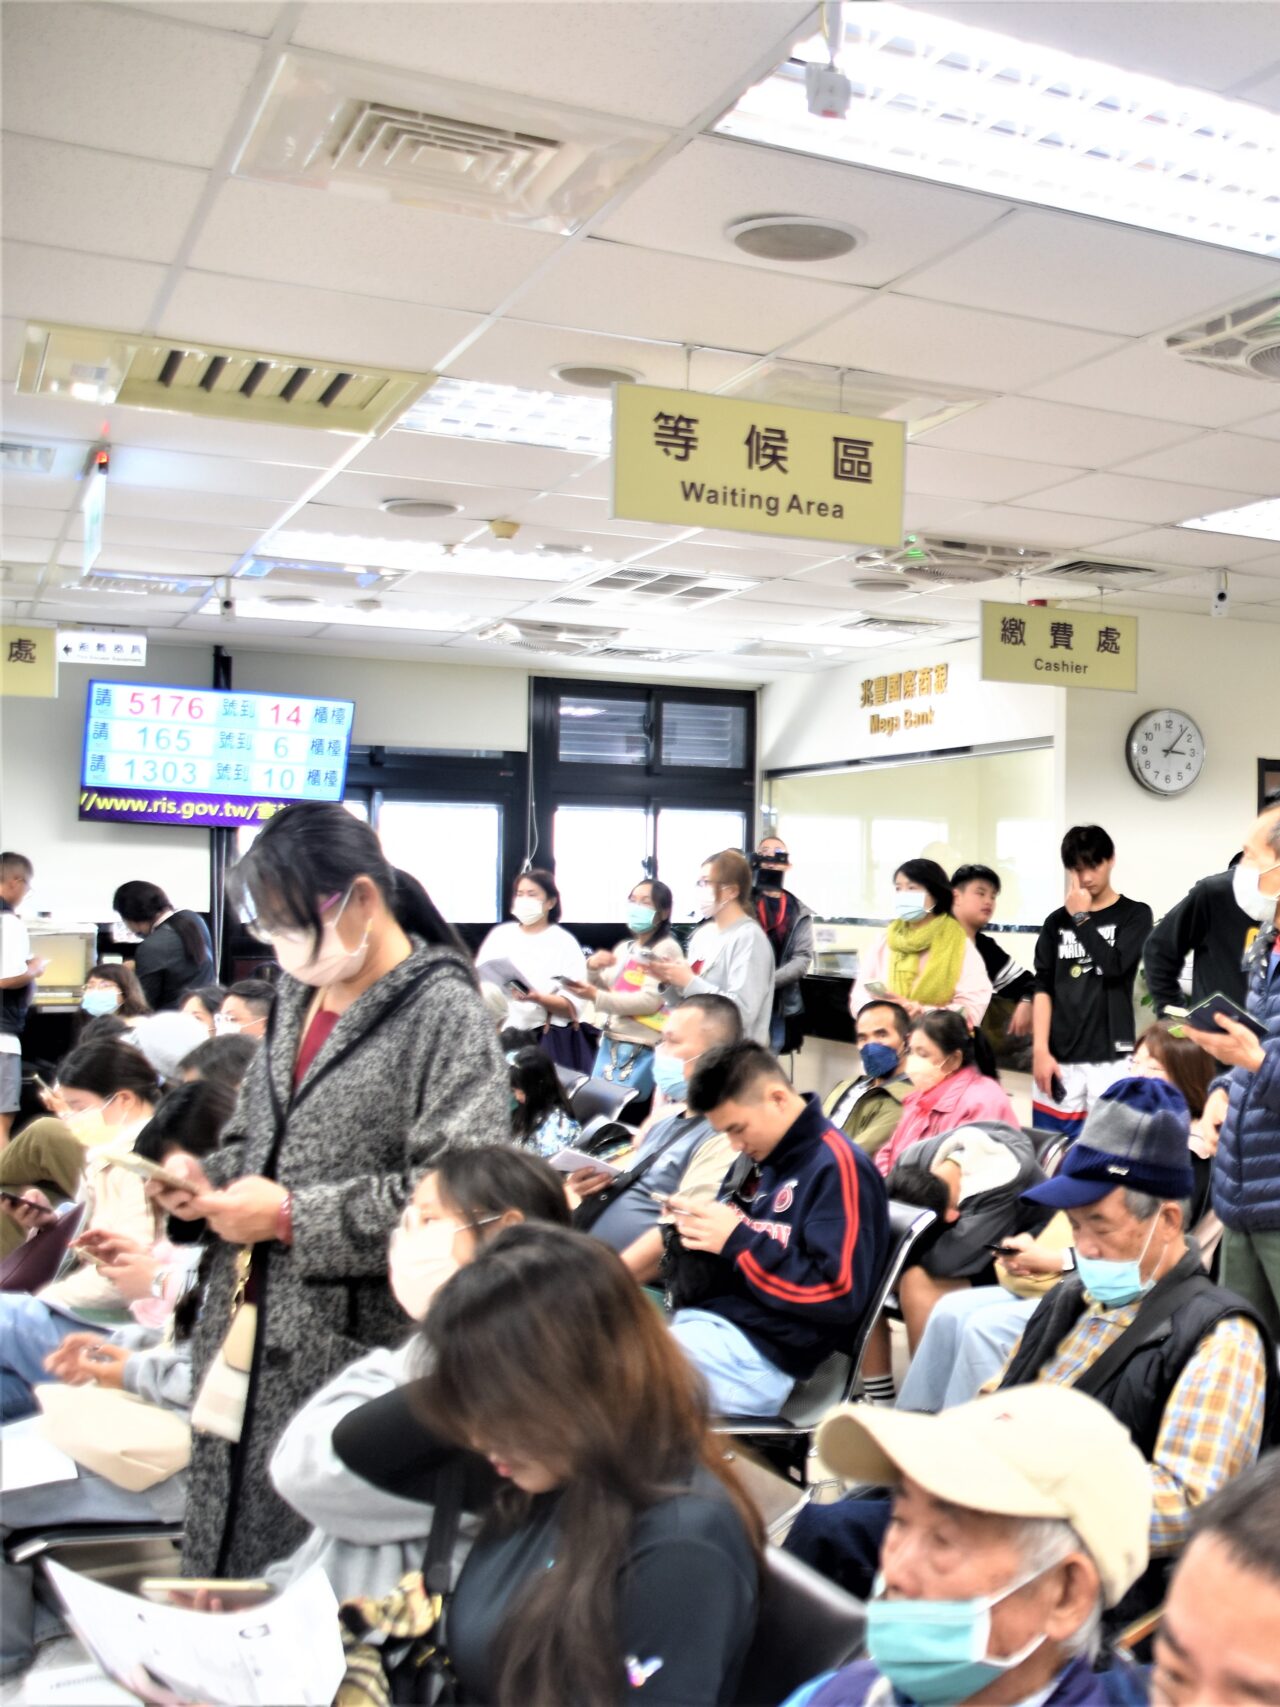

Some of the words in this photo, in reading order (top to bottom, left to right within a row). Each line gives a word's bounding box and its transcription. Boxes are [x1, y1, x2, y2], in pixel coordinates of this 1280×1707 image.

[653, 411, 874, 484] 等候區
[680, 481, 779, 516] Waiting
[786, 494, 844, 519] Area
[1000, 617, 1121, 654] 繳費處
[8, 638, 36, 663] 處
[1034, 658, 1088, 674] Cashier
[129, 692, 203, 719] 5176
[271, 704, 301, 725] 14
[870, 714, 900, 737] Mega
[904, 705, 935, 729] Bank
[1165, 720, 1173, 729] 12
[1154, 723, 1160, 731] 11
[1144, 732, 1153, 741] 10
[1186, 734, 1192, 743] 2
[138, 727, 191, 751] 165
[274, 737, 288, 758] 6
[1141, 746, 1148, 754] 9
[1190, 748, 1196, 757] 3
[1145, 761, 1151, 769] 8
[125, 759, 196, 784] 1303
[264, 768, 294, 790] 10
[1154, 771, 1160, 779] 7
[1177, 772, 1183, 781] 5
[1165, 775, 1171, 784] 6
